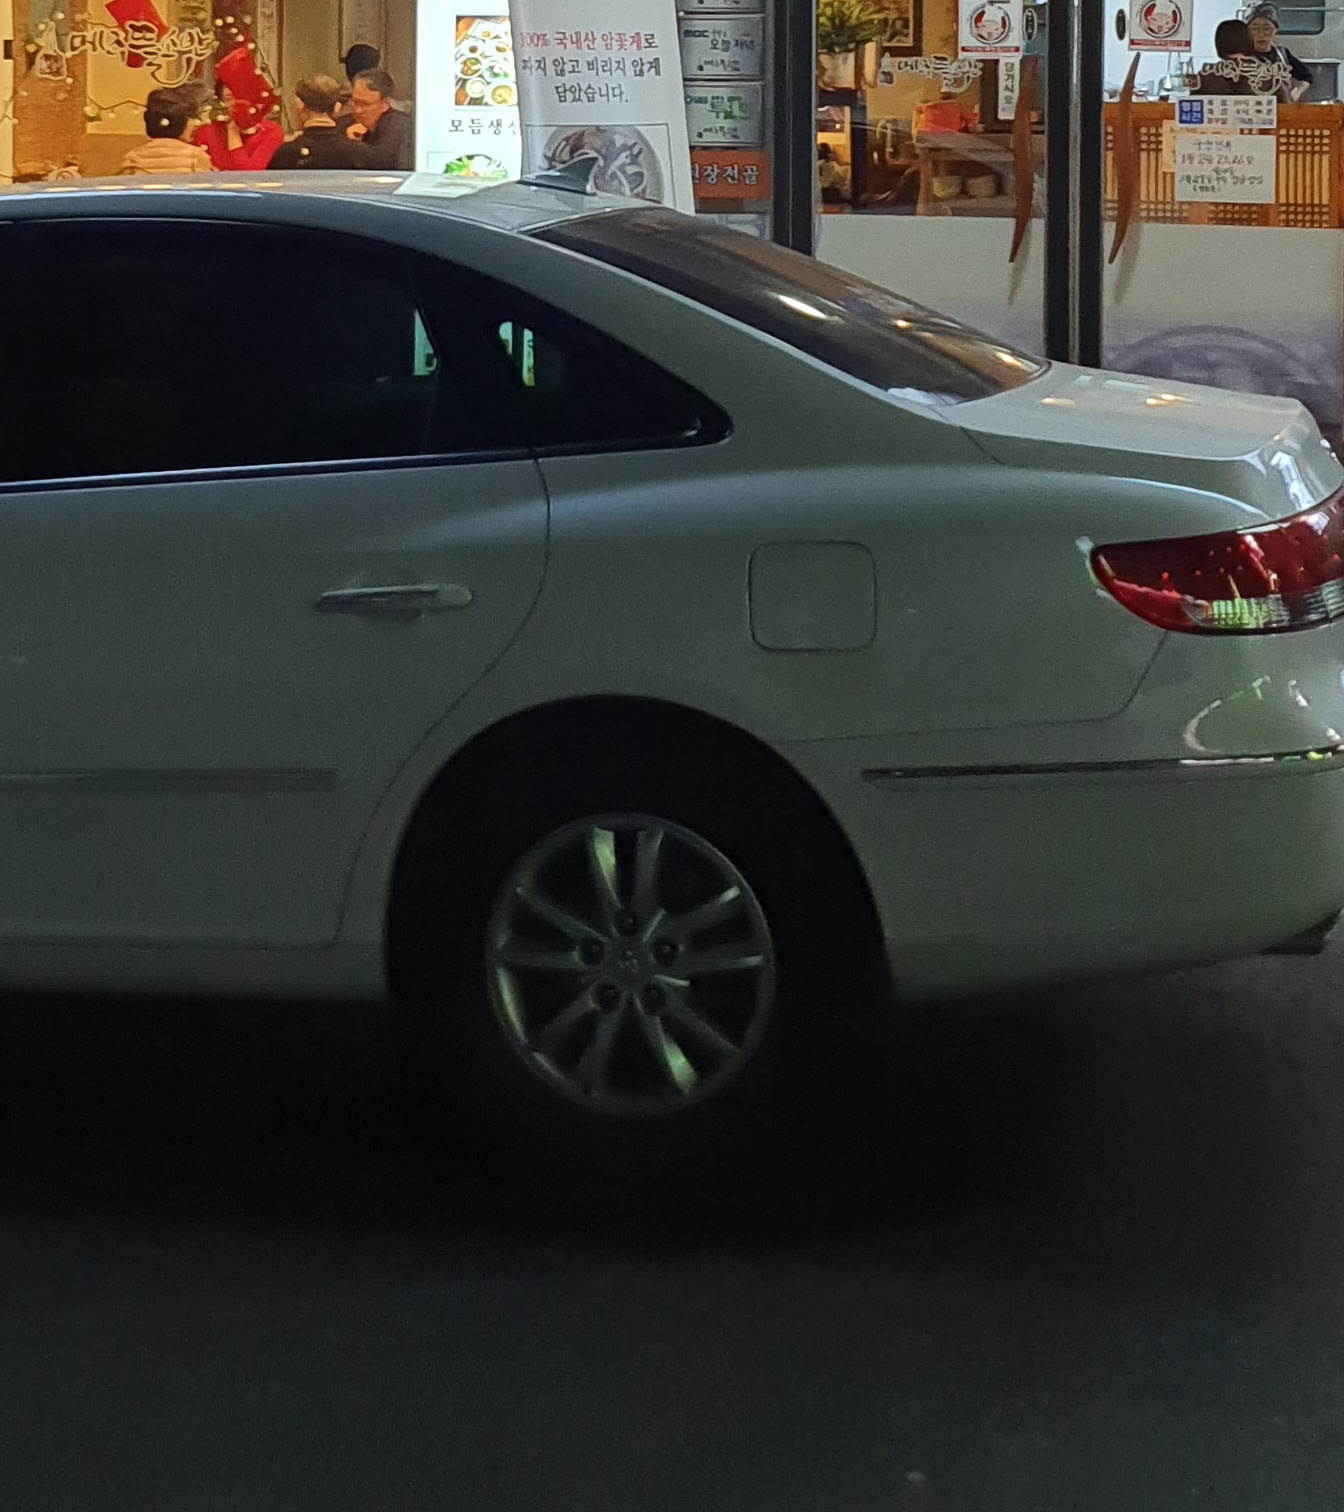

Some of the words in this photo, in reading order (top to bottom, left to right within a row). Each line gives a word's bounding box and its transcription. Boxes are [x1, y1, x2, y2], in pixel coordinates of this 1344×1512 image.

[555, 31, 597, 50] 국내산
[552, 58, 582, 76] 않고
[586, 58, 627, 76] 비리지
[554, 83, 629, 104] 담았습니다.
